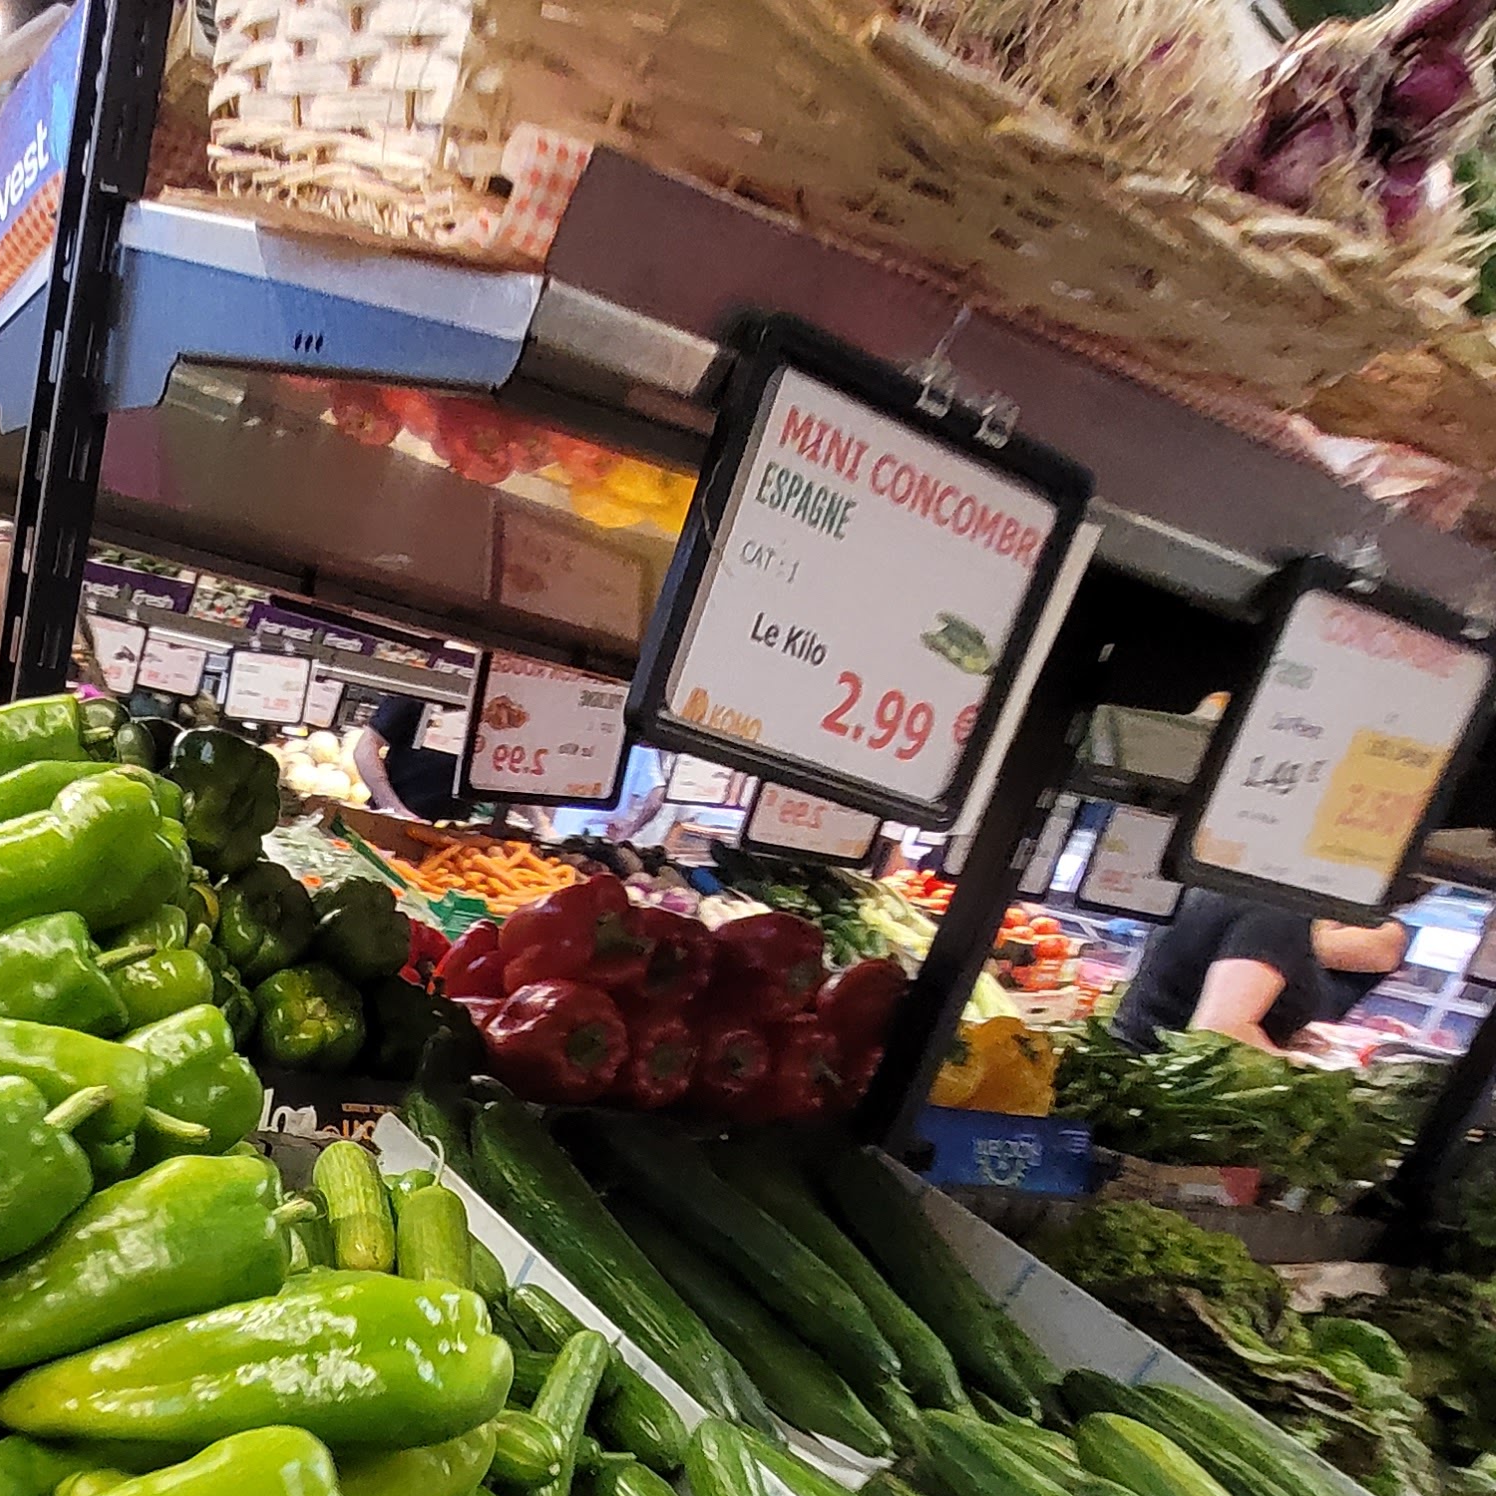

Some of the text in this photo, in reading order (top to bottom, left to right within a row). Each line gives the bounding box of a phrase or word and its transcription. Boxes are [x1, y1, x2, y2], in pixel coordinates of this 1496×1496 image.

[779, 404, 870, 485] MINI
[755, 461, 860, 541] ESPAGNE
[738, 540, 777, 572] CAT
[750, 611, 828, 667] Le Kilo
[819, 670, 935, 762] 2.99
